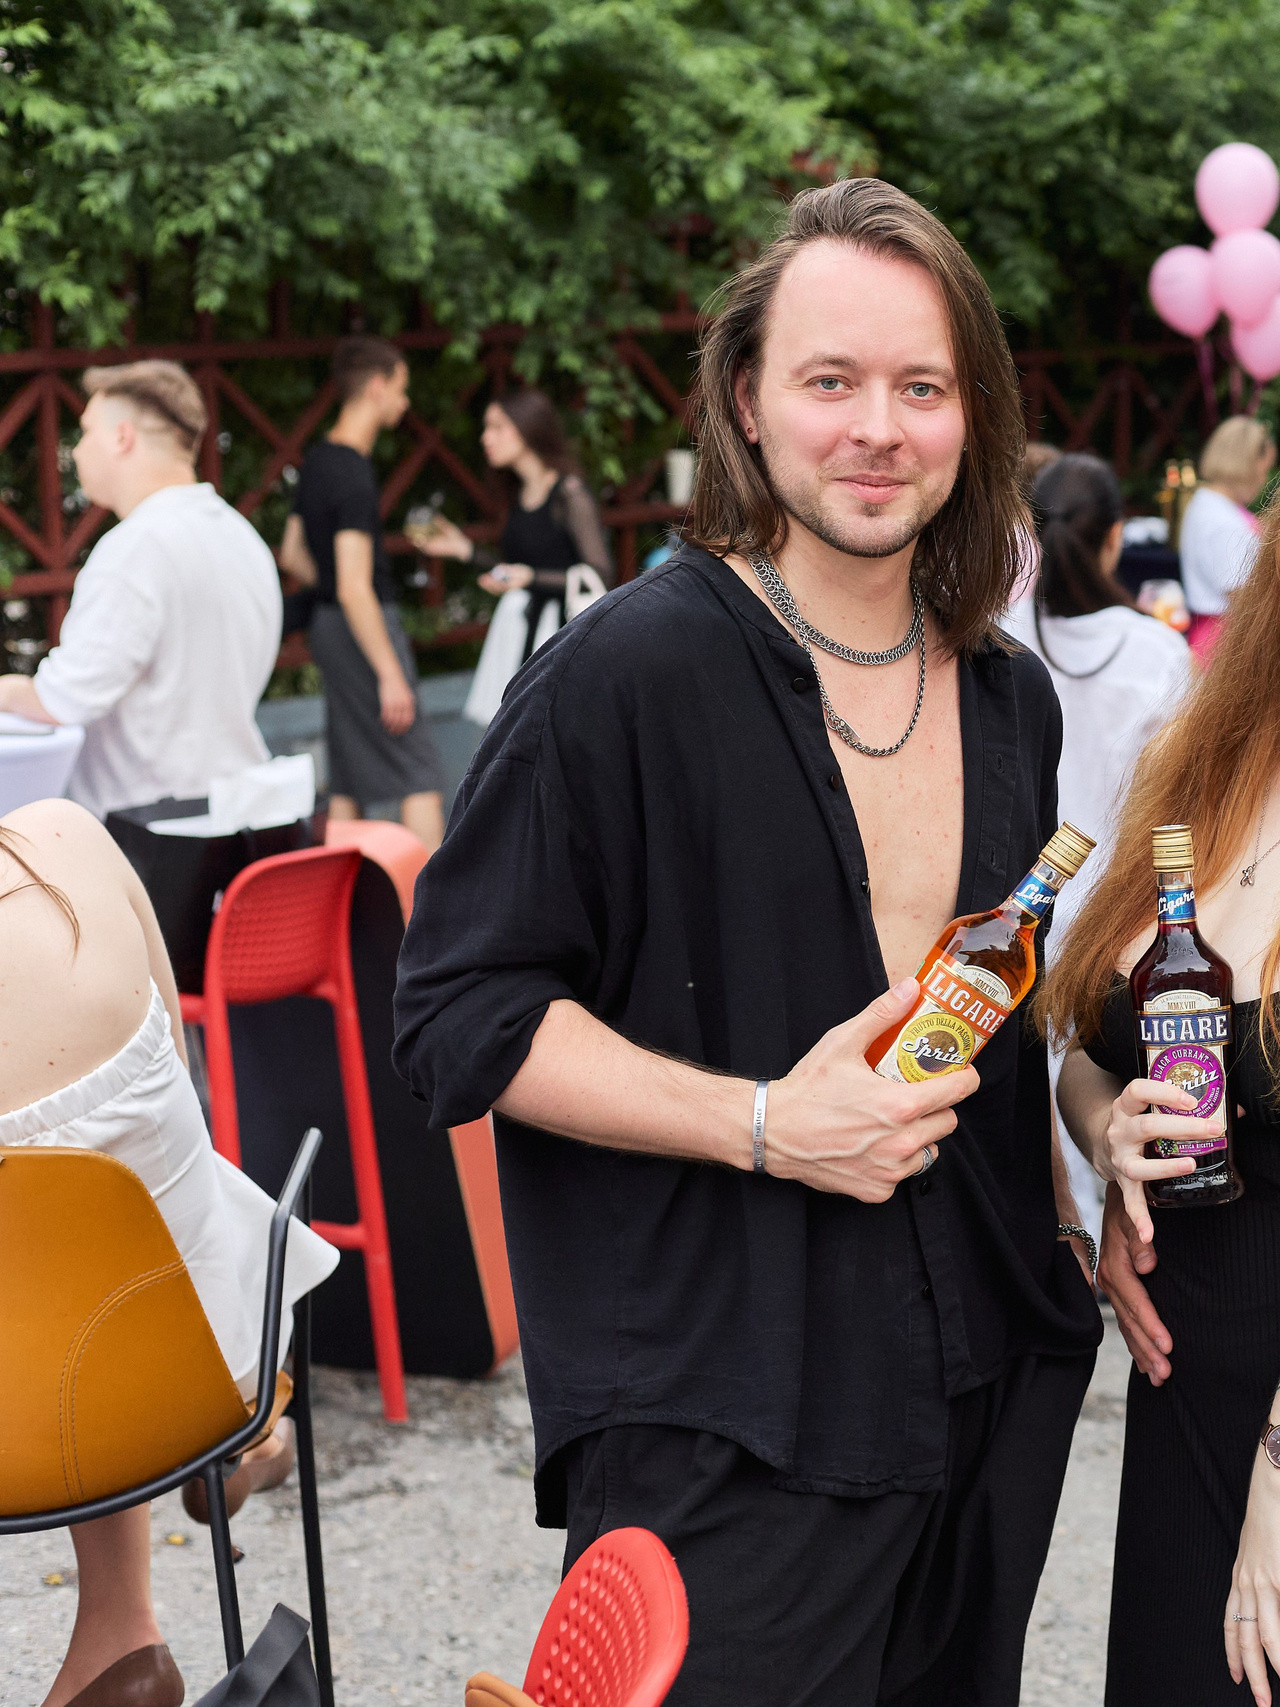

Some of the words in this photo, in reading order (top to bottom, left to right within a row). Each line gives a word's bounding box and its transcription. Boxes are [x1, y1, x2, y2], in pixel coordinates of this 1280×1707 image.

[1015, 883, 1056, 906] Ligar
[928, 970, 1006, 1034] LIGARE
[1167, 1001, 1196, 1010] MMXVIII
[909, 1019, 935, 1037] FRUTTO
[936, 1017, 956, 1030] DELLA
[1140, 1015, 1227, 1041] LIGARE
[902, 1036, 966, 1064] Spritz
[1153, 1055, 1171, 1079] BLACK
[1171, 1049, 1209, 1063] CURRANT
[1164, 1070, 1219, 1091] ritz
